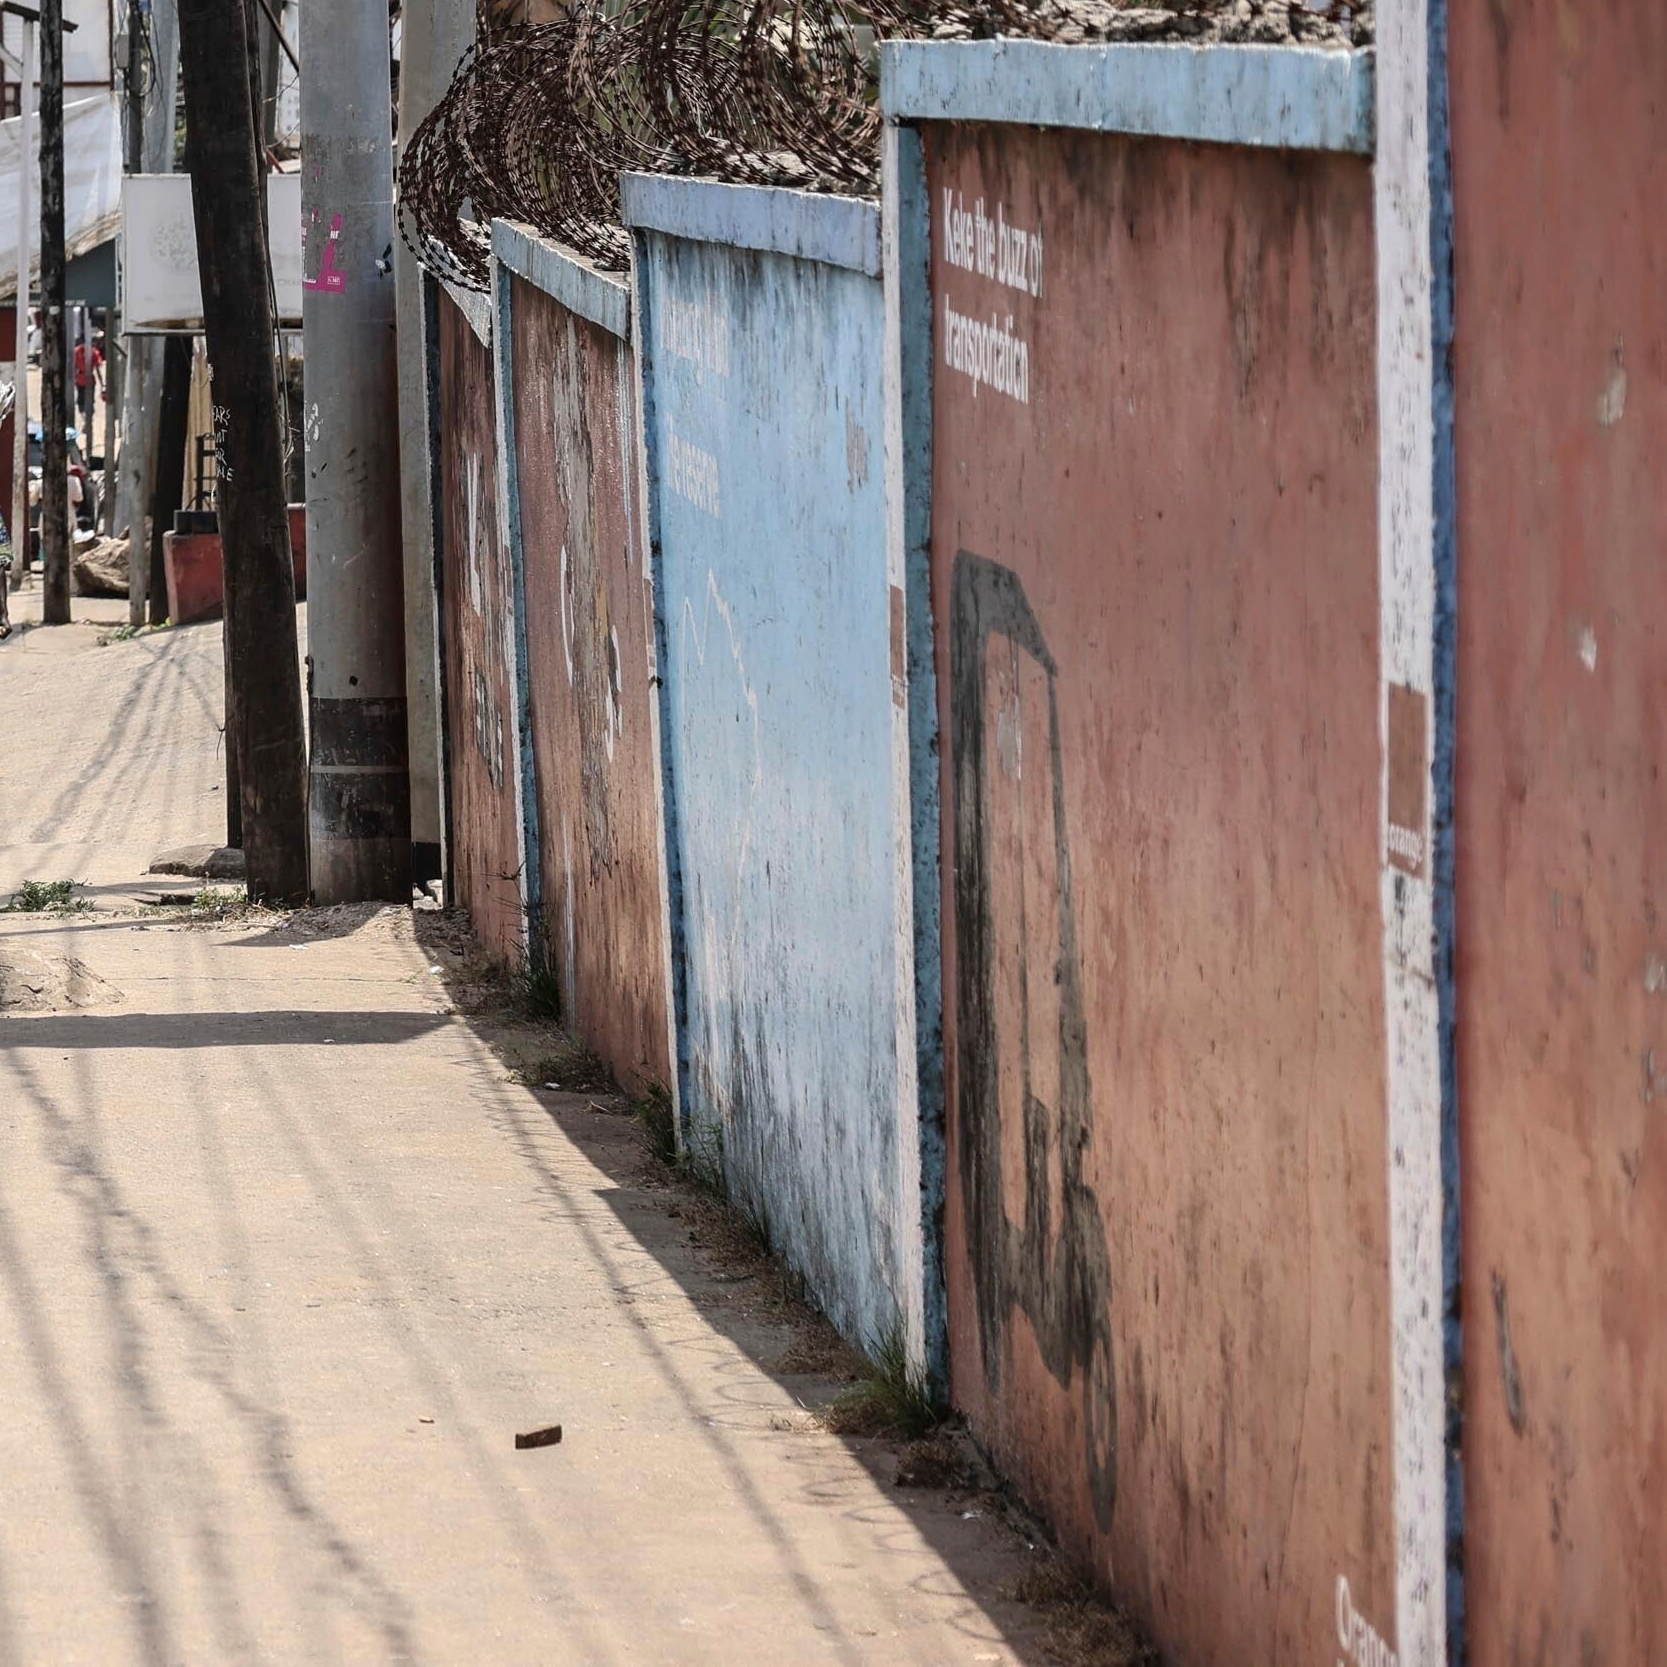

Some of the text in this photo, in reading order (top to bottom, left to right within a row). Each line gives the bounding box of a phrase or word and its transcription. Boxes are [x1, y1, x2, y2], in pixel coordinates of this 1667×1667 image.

[943, 187, 1043, 298] Keke the buzz of
[944, 293, 1029, 405] transportation
